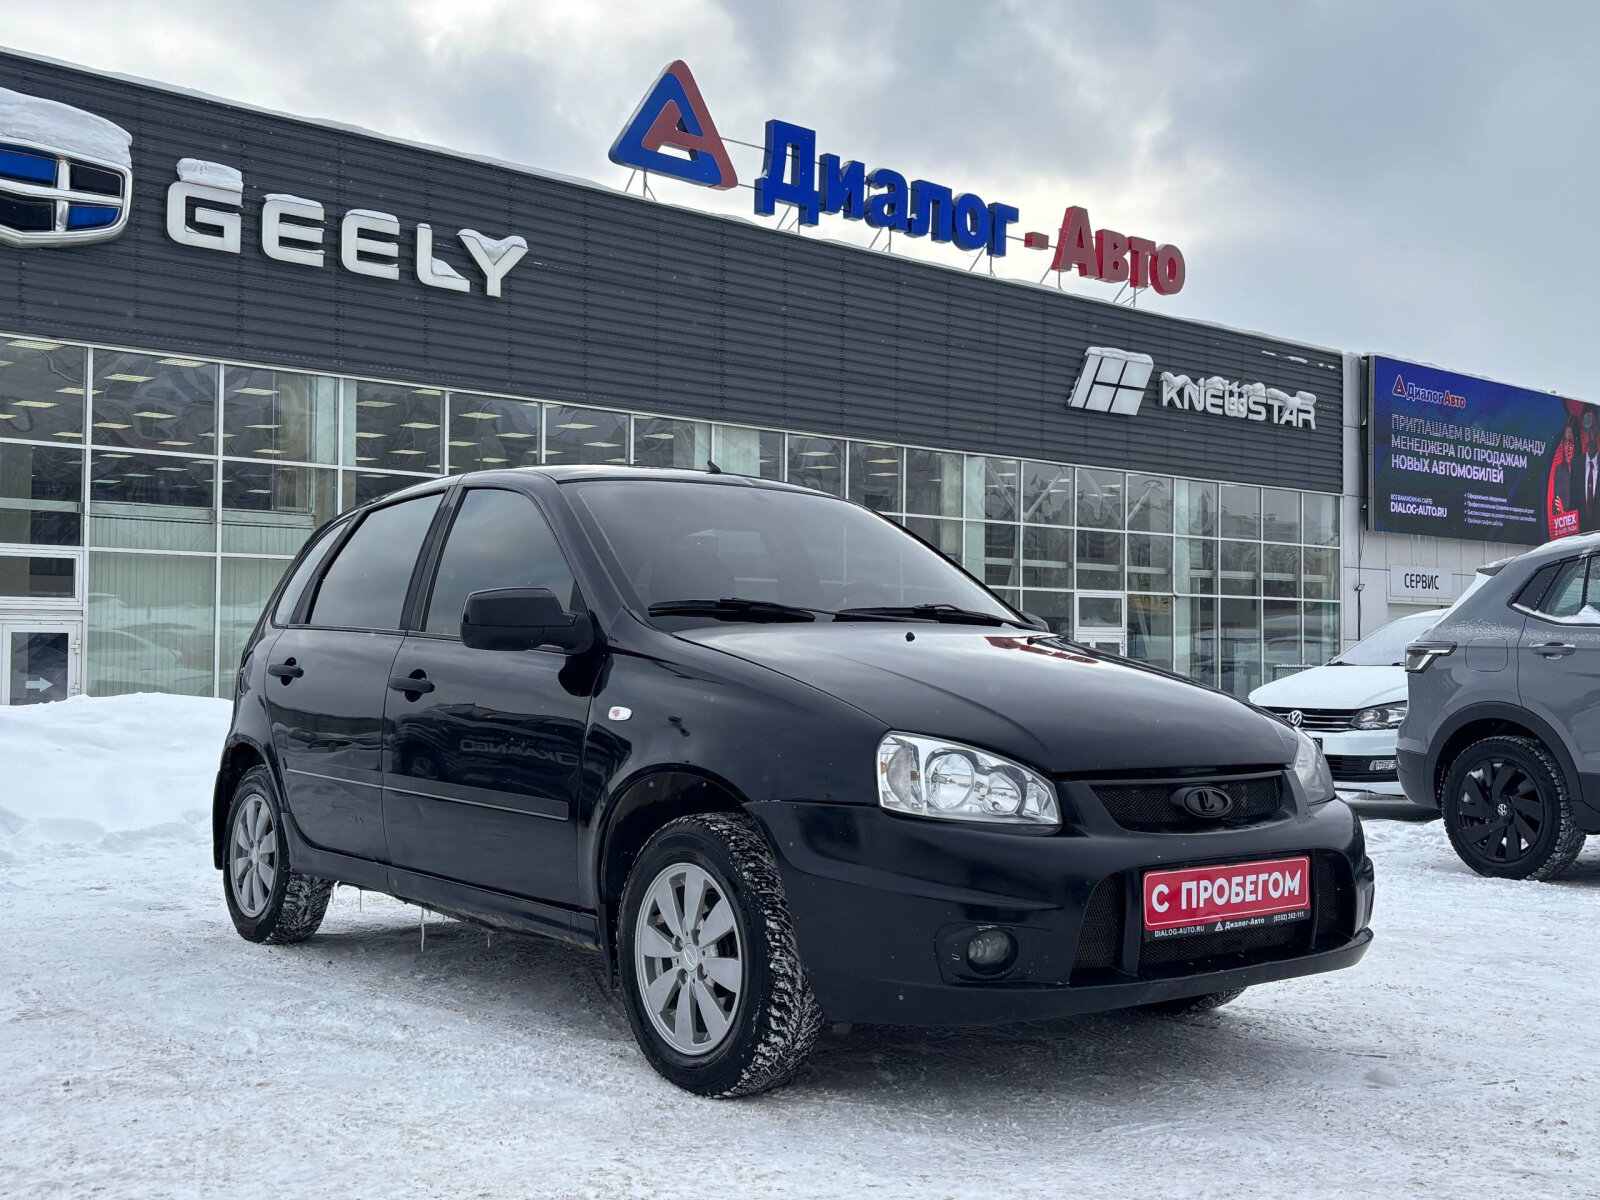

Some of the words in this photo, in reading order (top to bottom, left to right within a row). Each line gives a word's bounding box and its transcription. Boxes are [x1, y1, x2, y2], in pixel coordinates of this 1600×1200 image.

[165, 180, 529, 298] GEELY
[1159, 373, 1317, 430] KNEWSTAR
[1391, 413, 1462, 440] ПРИГЛАШАЕМ
[1464, 427, 1471, 442] В
[1473, 428, 1501, 447] НАШУ
[1503, 434, 1546, 457] КОМАНДУ
[1391, 434, 1456, 457] МЕНЕДЖЕРА
[1457, 445, 1472, 460] ПО
[1473, 448, 1528, 470] ПРОДАЖАМ
[1391, 453, 1430, 473] НОВЫХ
[1431, 459, 1504, 483] АВТОМОБИЛЕЙ
[1390, 501, 1448, 518] DIALOG-AUTO.RU
[1554, 513, 1577, 530] УСПЕХ
[1404, 573, 1440, 590] СЕРВИС
[1151, 884, 1170, 913] С
[1180, 868, 1302, 910] ПРОБЕГОМ
[1154, 925, 1205, 938] DIALOG-AUTO.RU
[1224, 917, 1265, 930] Диалог-Авто
